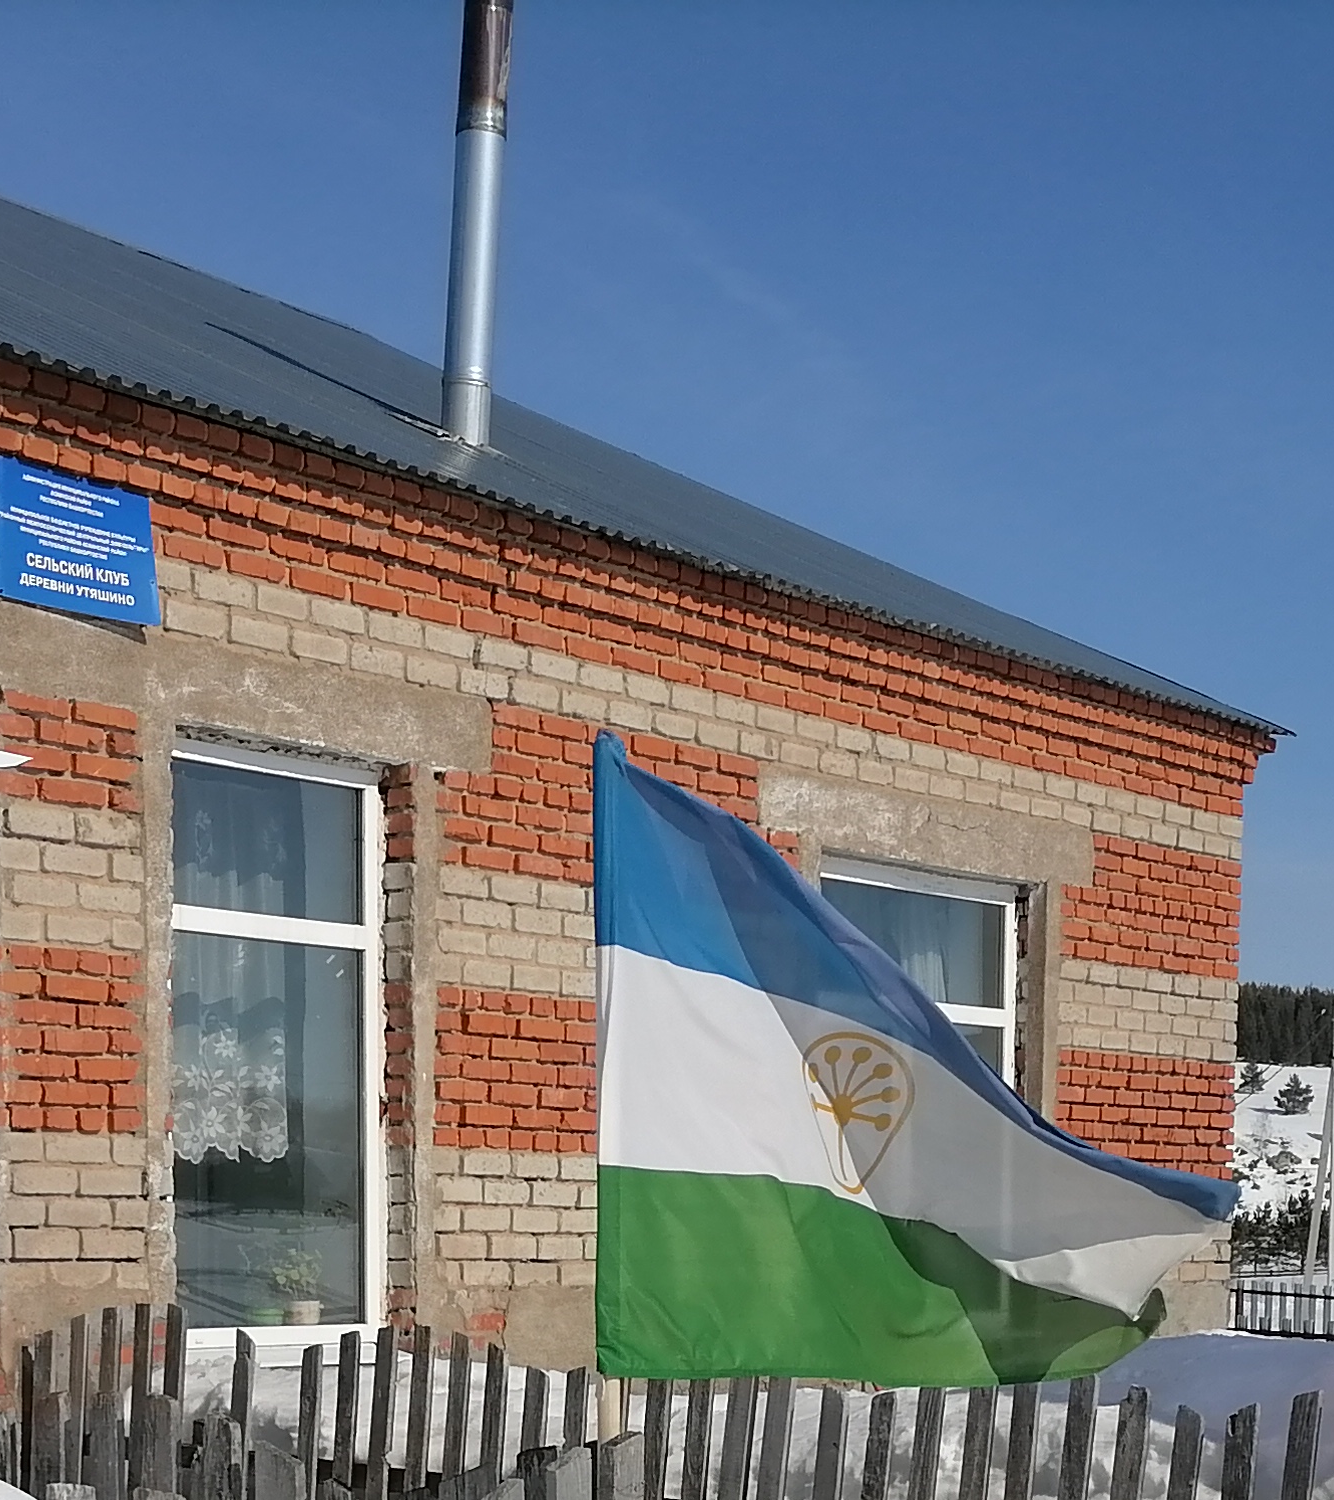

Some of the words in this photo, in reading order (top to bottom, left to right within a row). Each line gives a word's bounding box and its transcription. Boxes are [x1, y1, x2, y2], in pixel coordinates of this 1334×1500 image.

[26, 552, 94, 581] СЕЛЬСКИЙ
[96, 567, 130, 587] КЛУБ
[19, 572, 74, 594] ДЕРЕВНИ
[76, 585, 135, 606] УТЯШИНО
